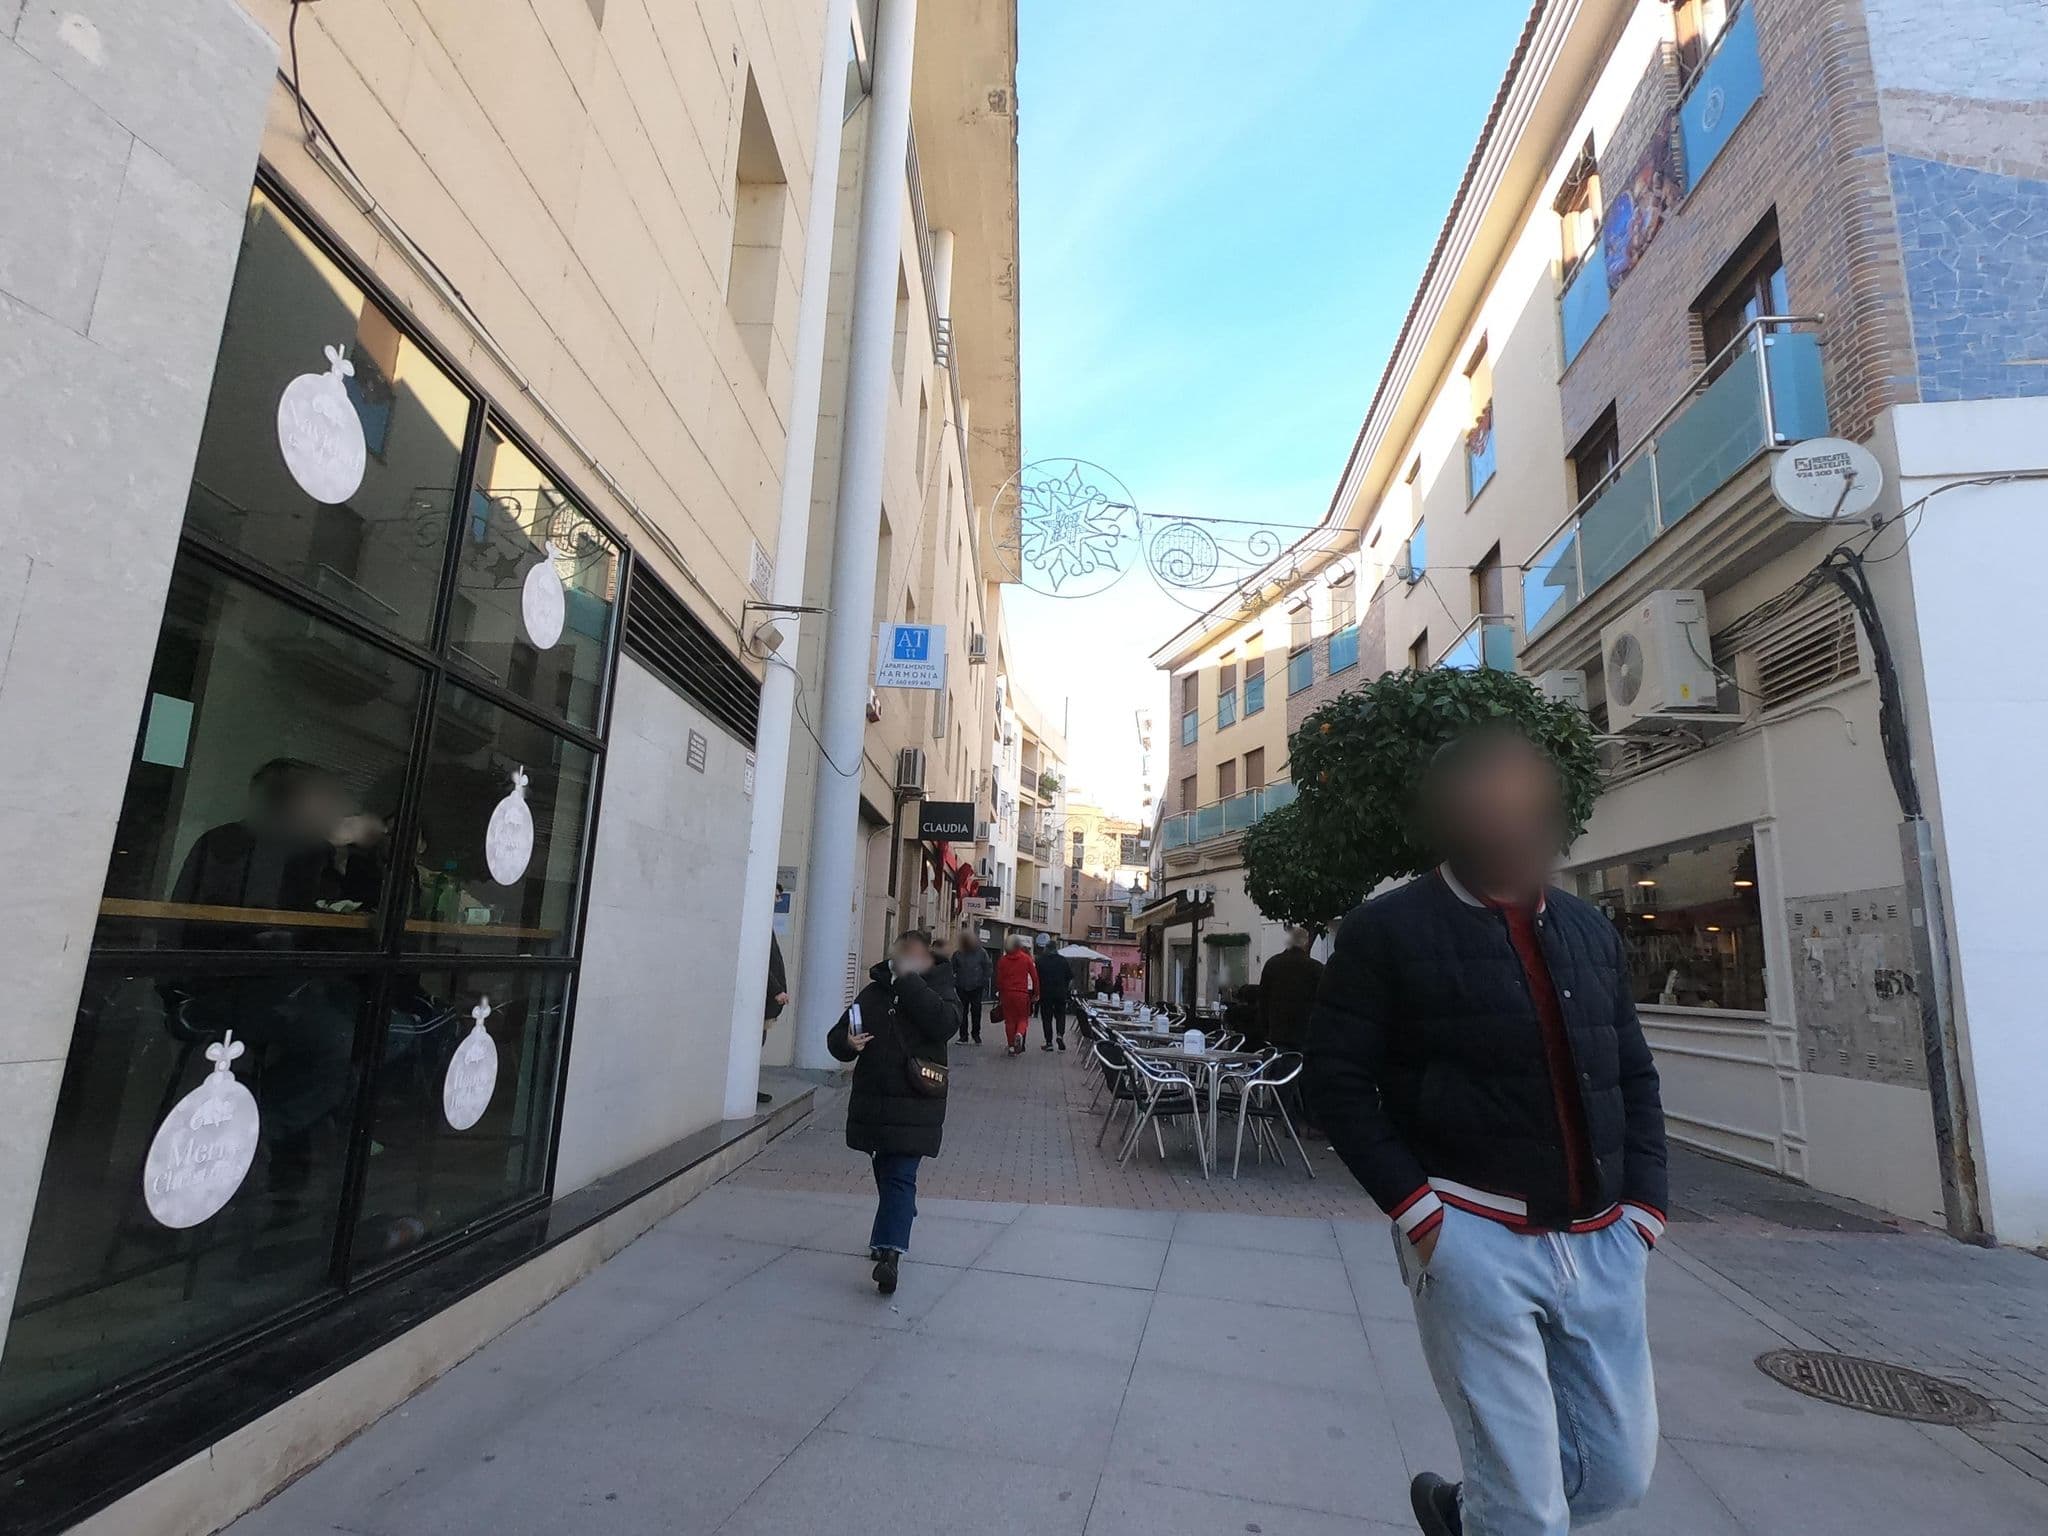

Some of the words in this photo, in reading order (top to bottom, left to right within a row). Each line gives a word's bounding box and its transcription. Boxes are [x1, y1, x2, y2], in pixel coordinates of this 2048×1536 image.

[1812, 452, 1850, 463] MERCATEL
[1813, 460, 1852, 470] SATELITE
[897, 630, 926, 648] AT
[885, 663, 935, 671] APARTAMENTOS
[880, 671, 938, 679] HARMONIA
[922, 822, 969, 833] CLAUDIA
